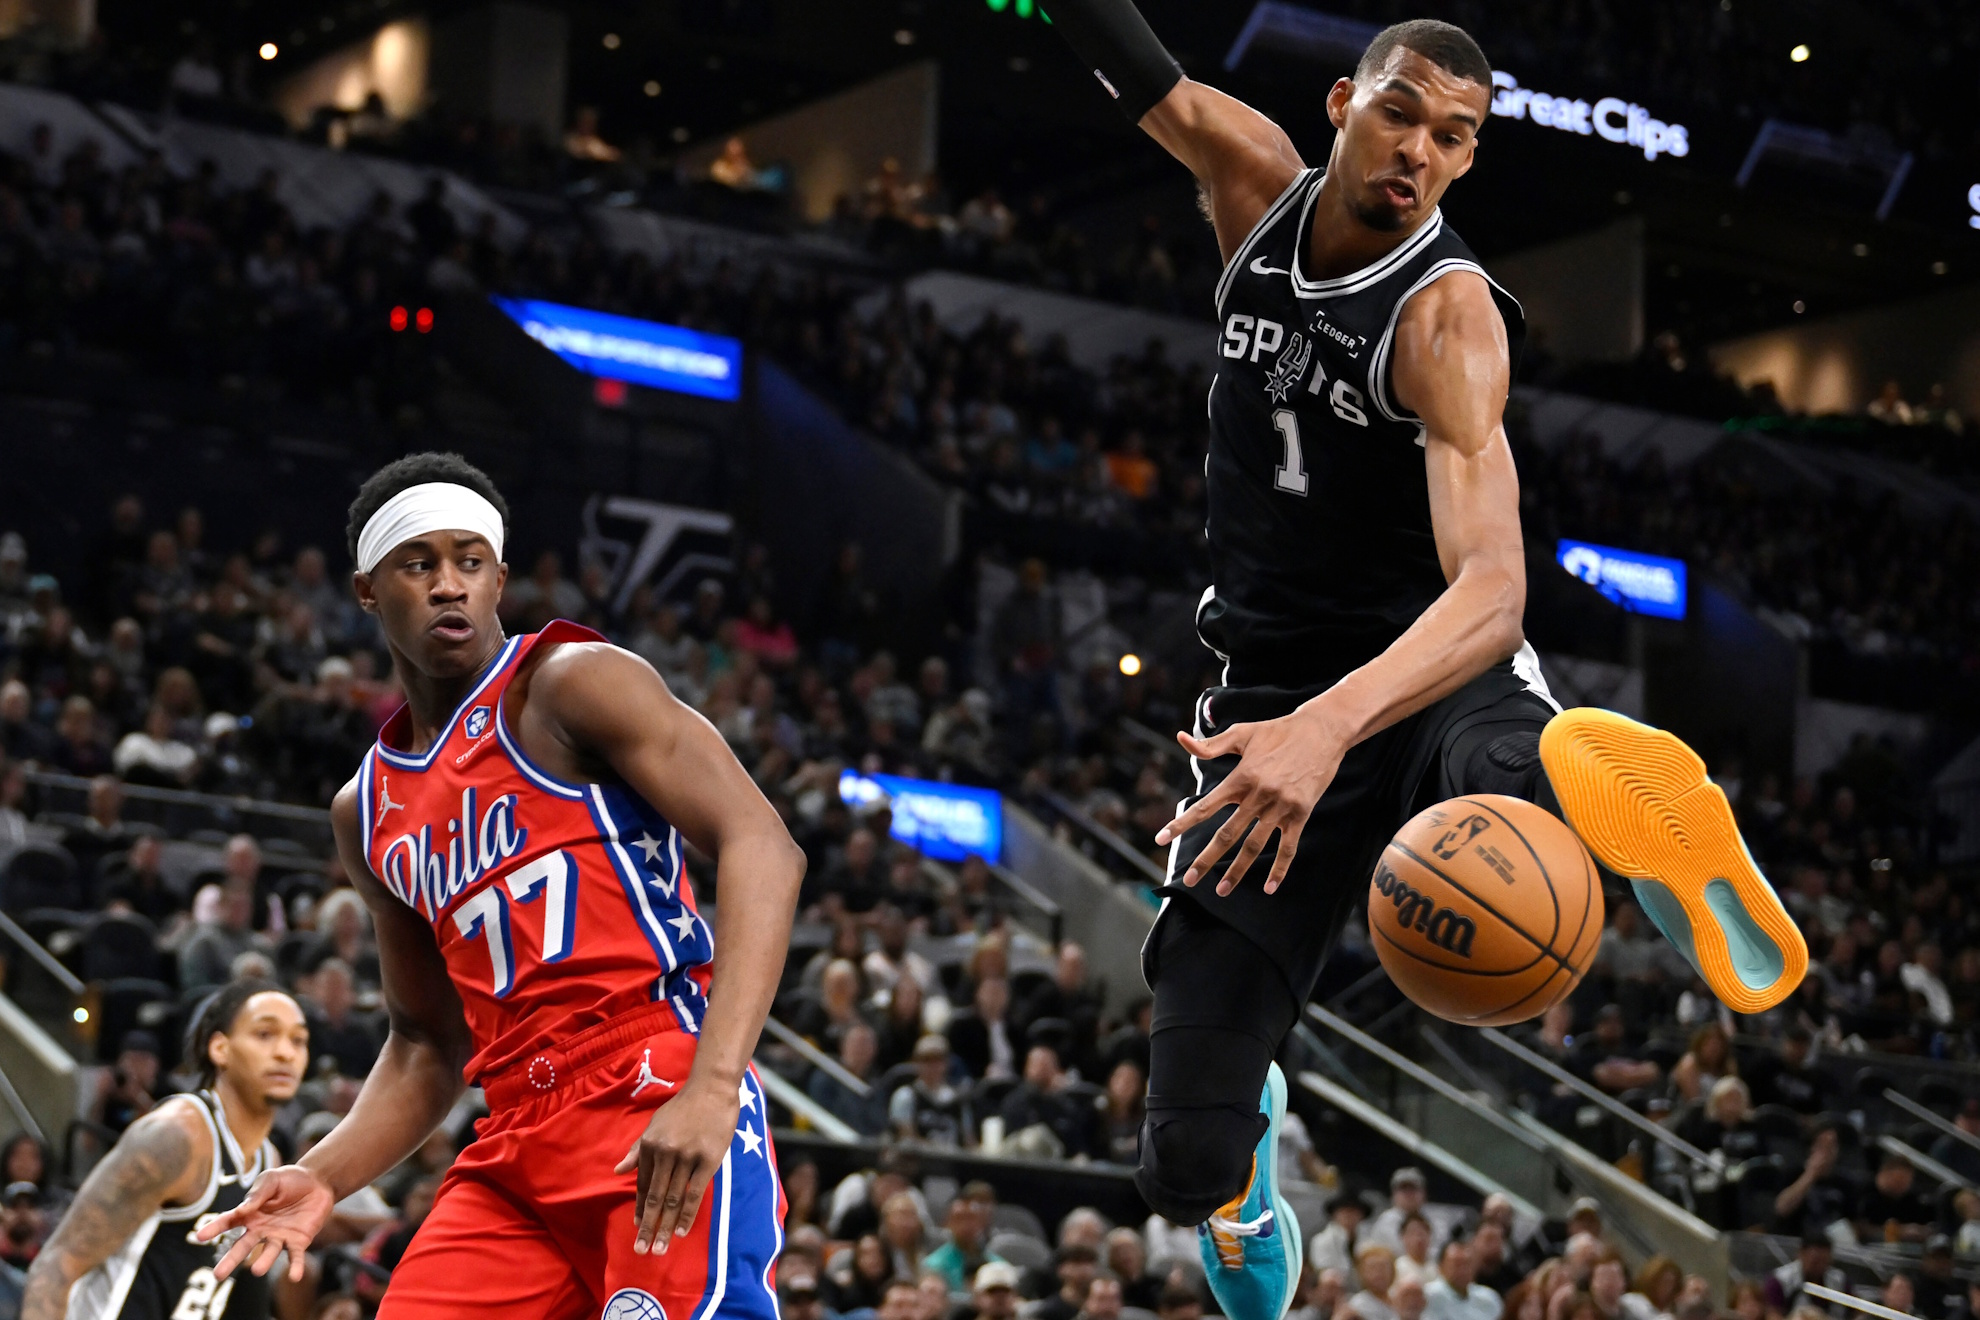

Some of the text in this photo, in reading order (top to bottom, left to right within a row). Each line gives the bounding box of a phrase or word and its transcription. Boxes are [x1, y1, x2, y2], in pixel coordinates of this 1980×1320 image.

[1491, 70, 1690, 162] Great Clips
[1316, 318, 1357, 350] LEDGER
[1271, 408, 1309, 497] 1
[382, 786, 528, 923] Phila
[452, 848, 580, 1000] 77
[1374, 859, 1477, 960] Wilson
